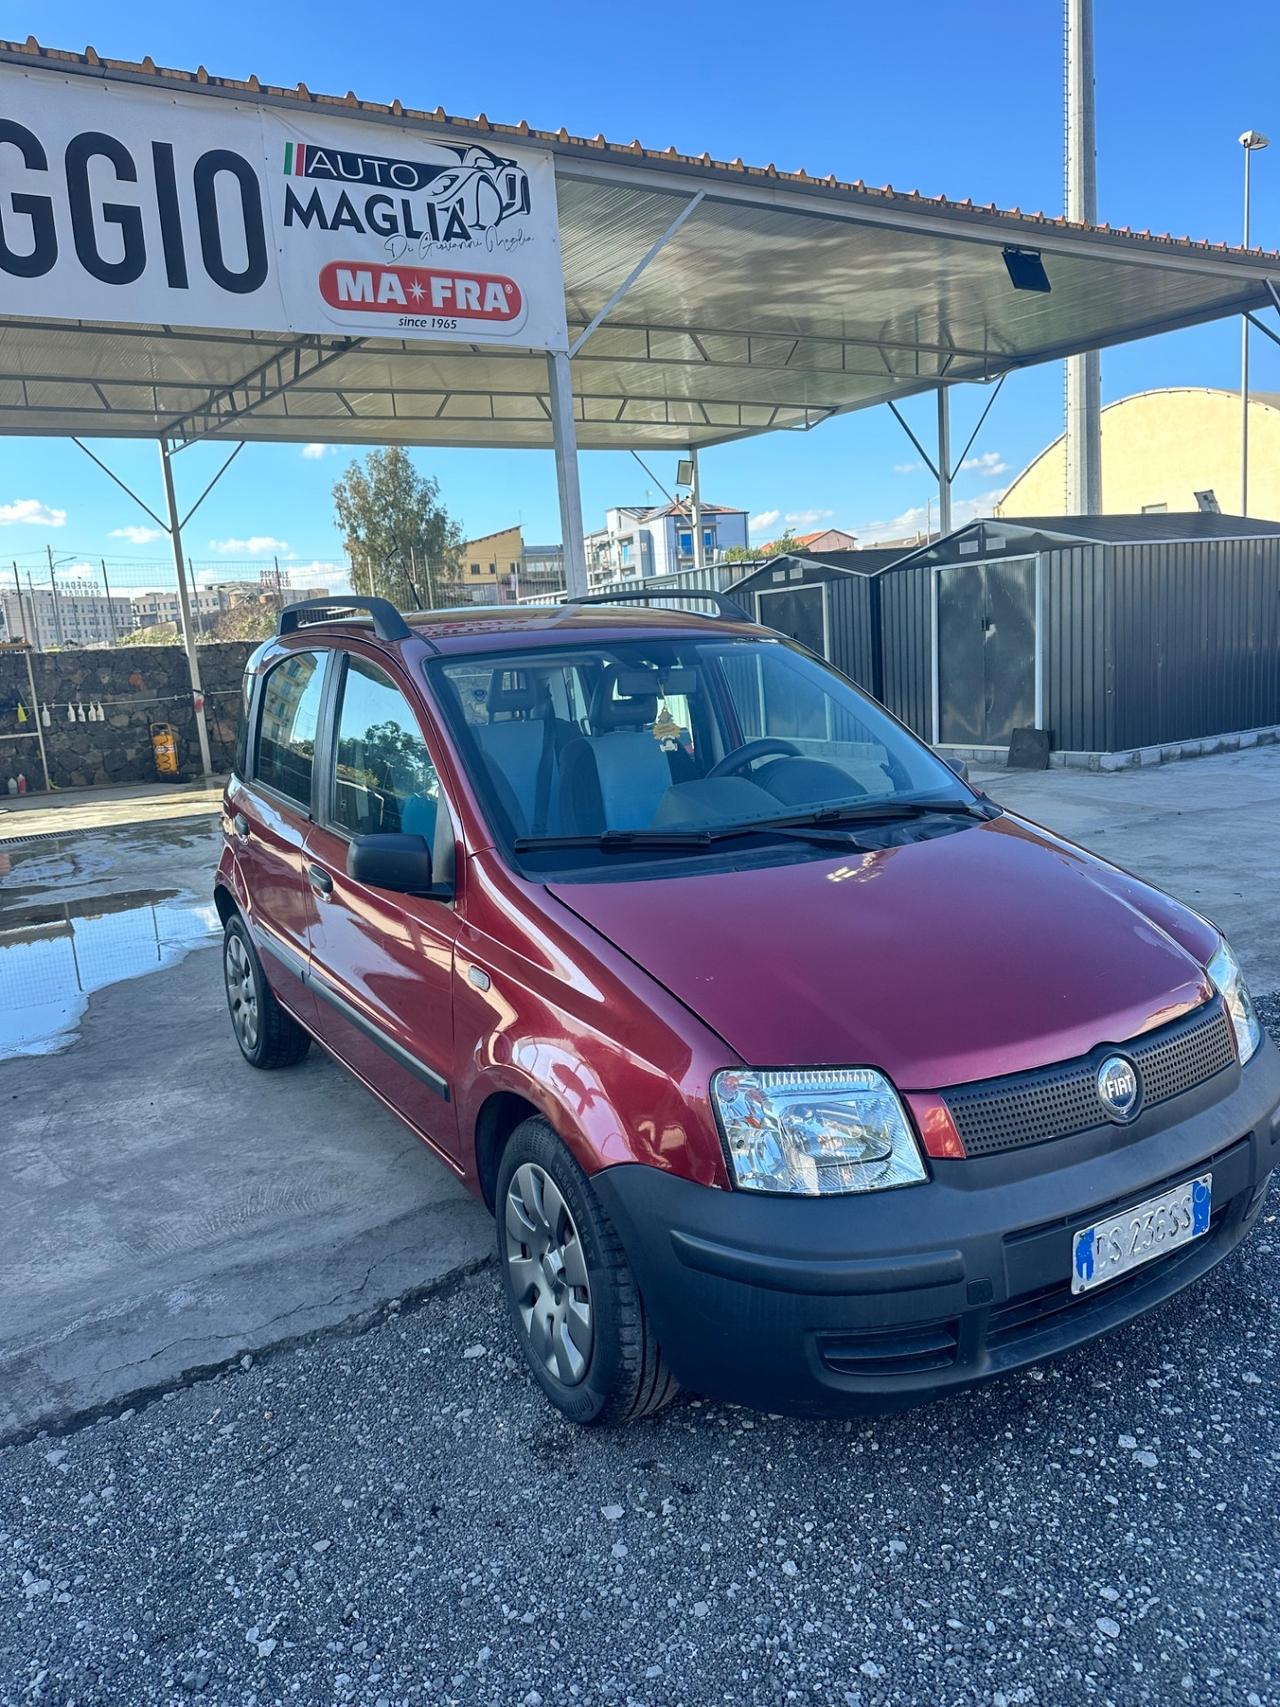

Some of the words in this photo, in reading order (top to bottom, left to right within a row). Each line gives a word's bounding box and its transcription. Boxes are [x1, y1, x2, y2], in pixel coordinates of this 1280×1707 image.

[307, 150, 419, 188] AUTO
[0, 118, 269, 294] GGIO
[283, 183, 472, 241] MAGLIA
[398, 316, 427, 328] since
[431, 318, 457, 329] 1965
[1106, 1075, 1131, 1098] FIAT
